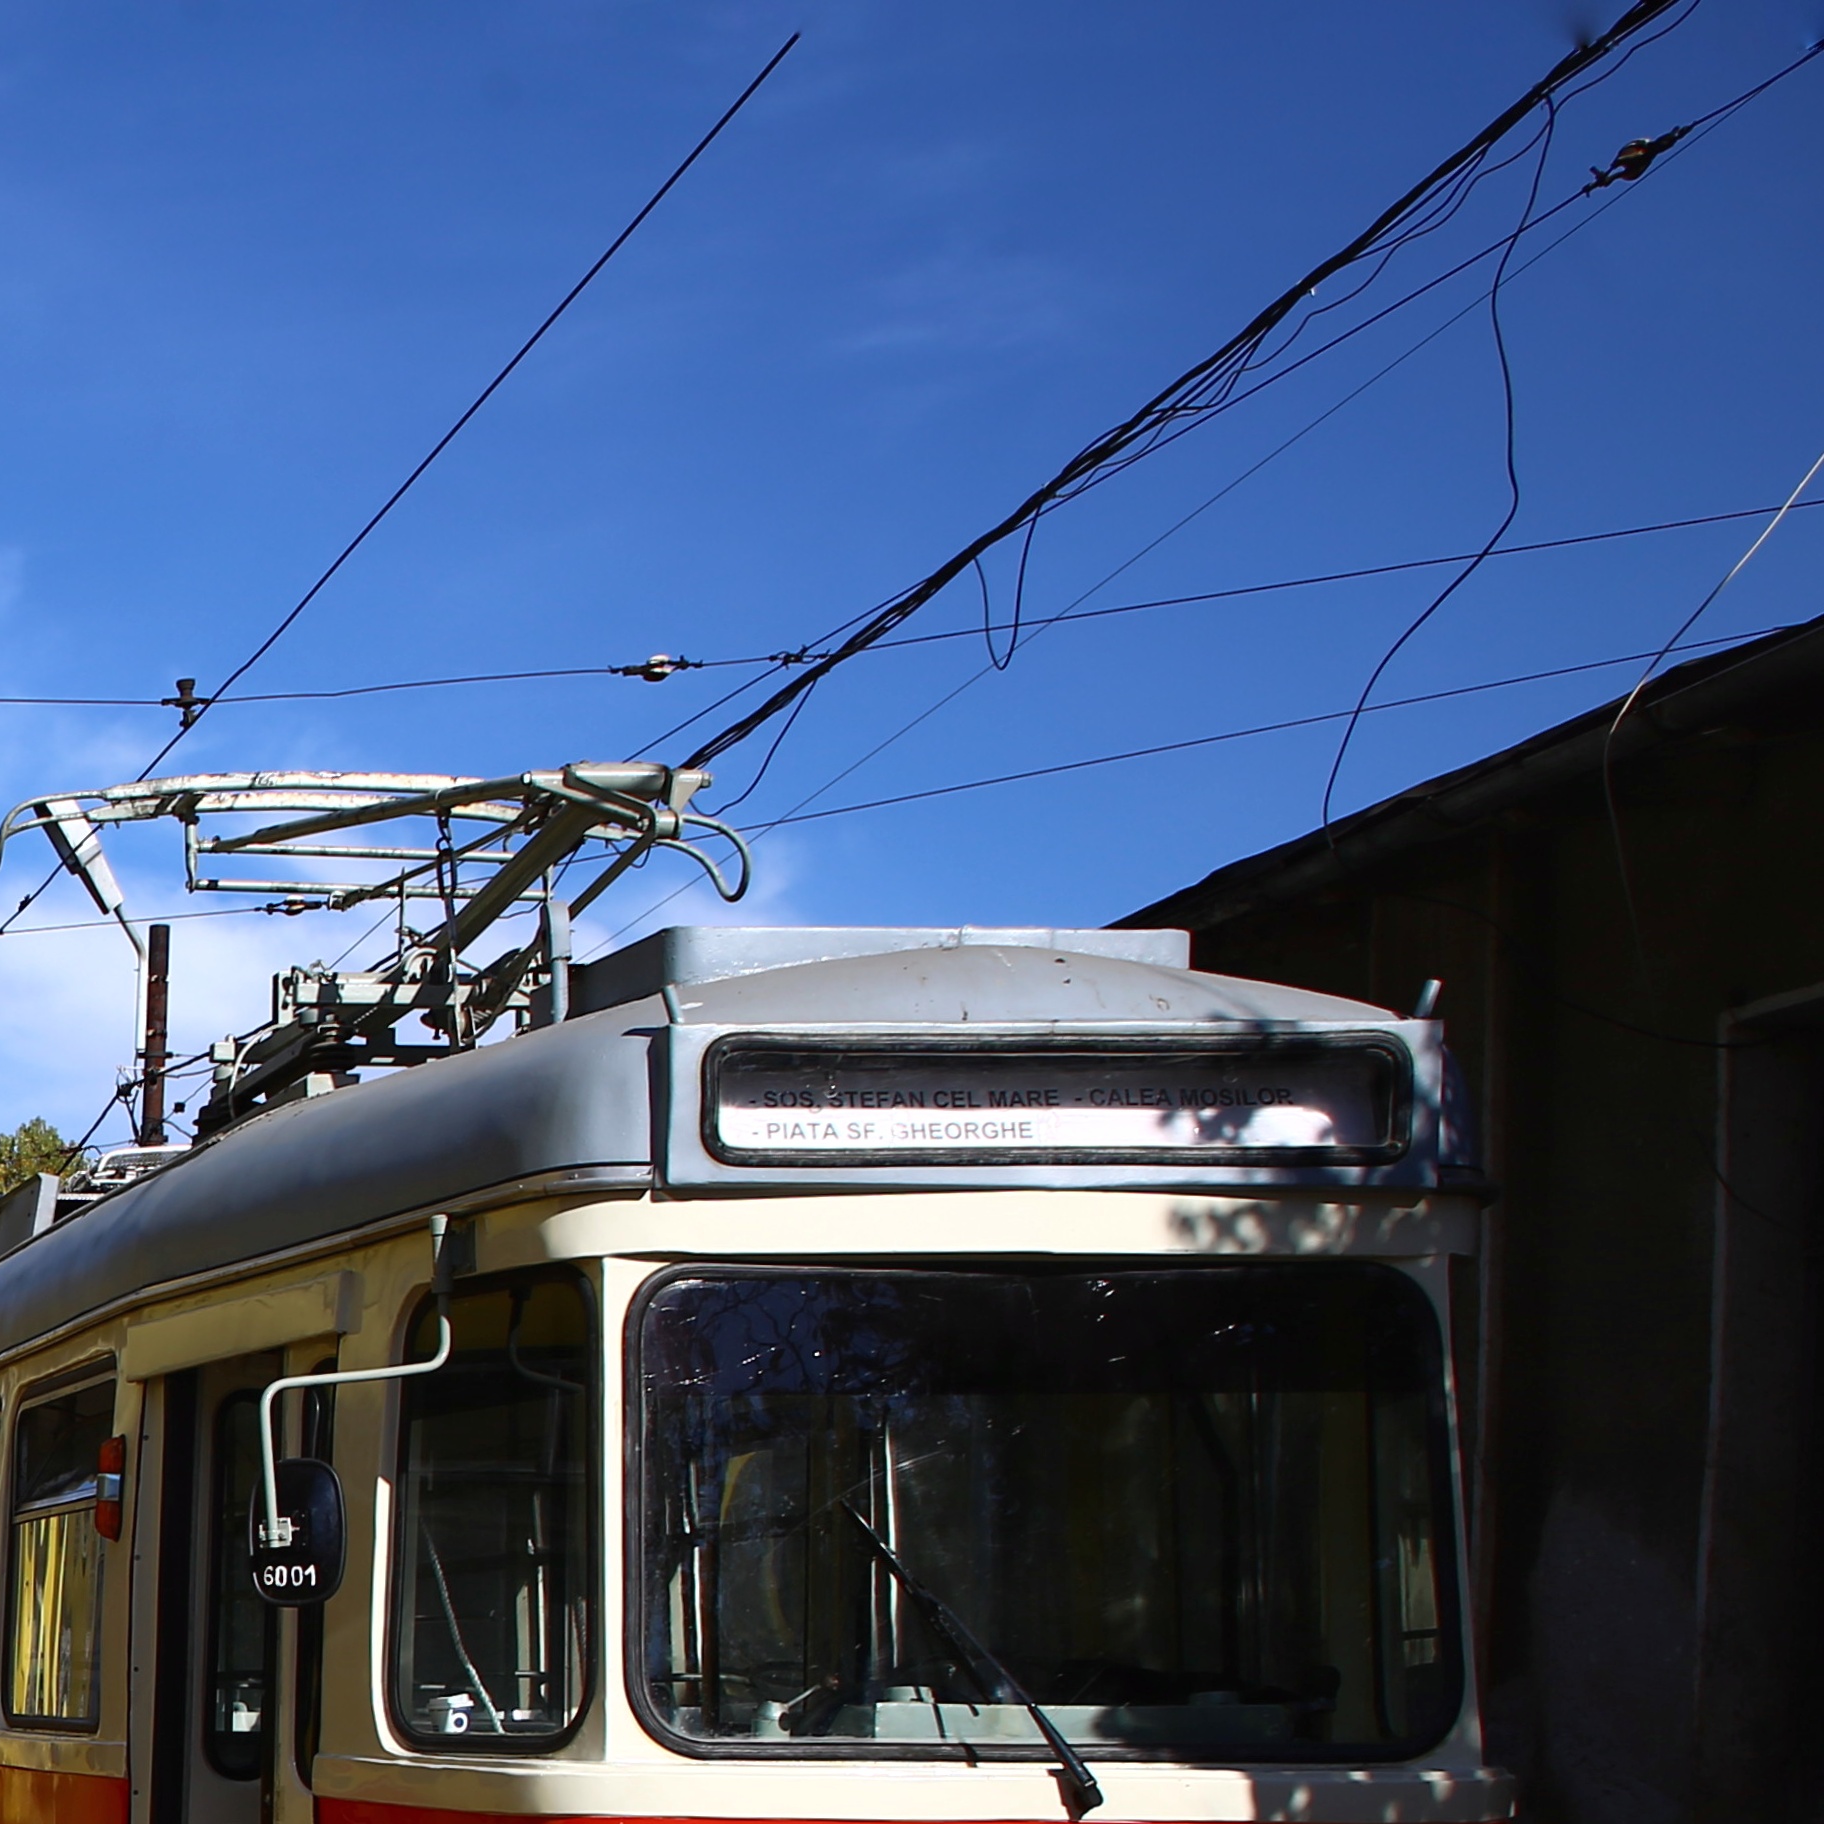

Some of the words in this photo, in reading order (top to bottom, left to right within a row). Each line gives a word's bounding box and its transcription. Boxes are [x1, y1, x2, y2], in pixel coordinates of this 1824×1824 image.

[828, 1089, 925, 1109] STEFAN
[931, 1089, 979, 1109] CEL
[988, 1089, 1060, 1108] MARE
[1089, 1087, 1172, 1107] CALEA
[1179, 1088, 1294, 1107] MOSILOR
[766, 1121, 840, 1139] PIATA
[847, 1122, 883, 1140] SF.
[892, 1121, 1034, 1140] GHEORGHE
